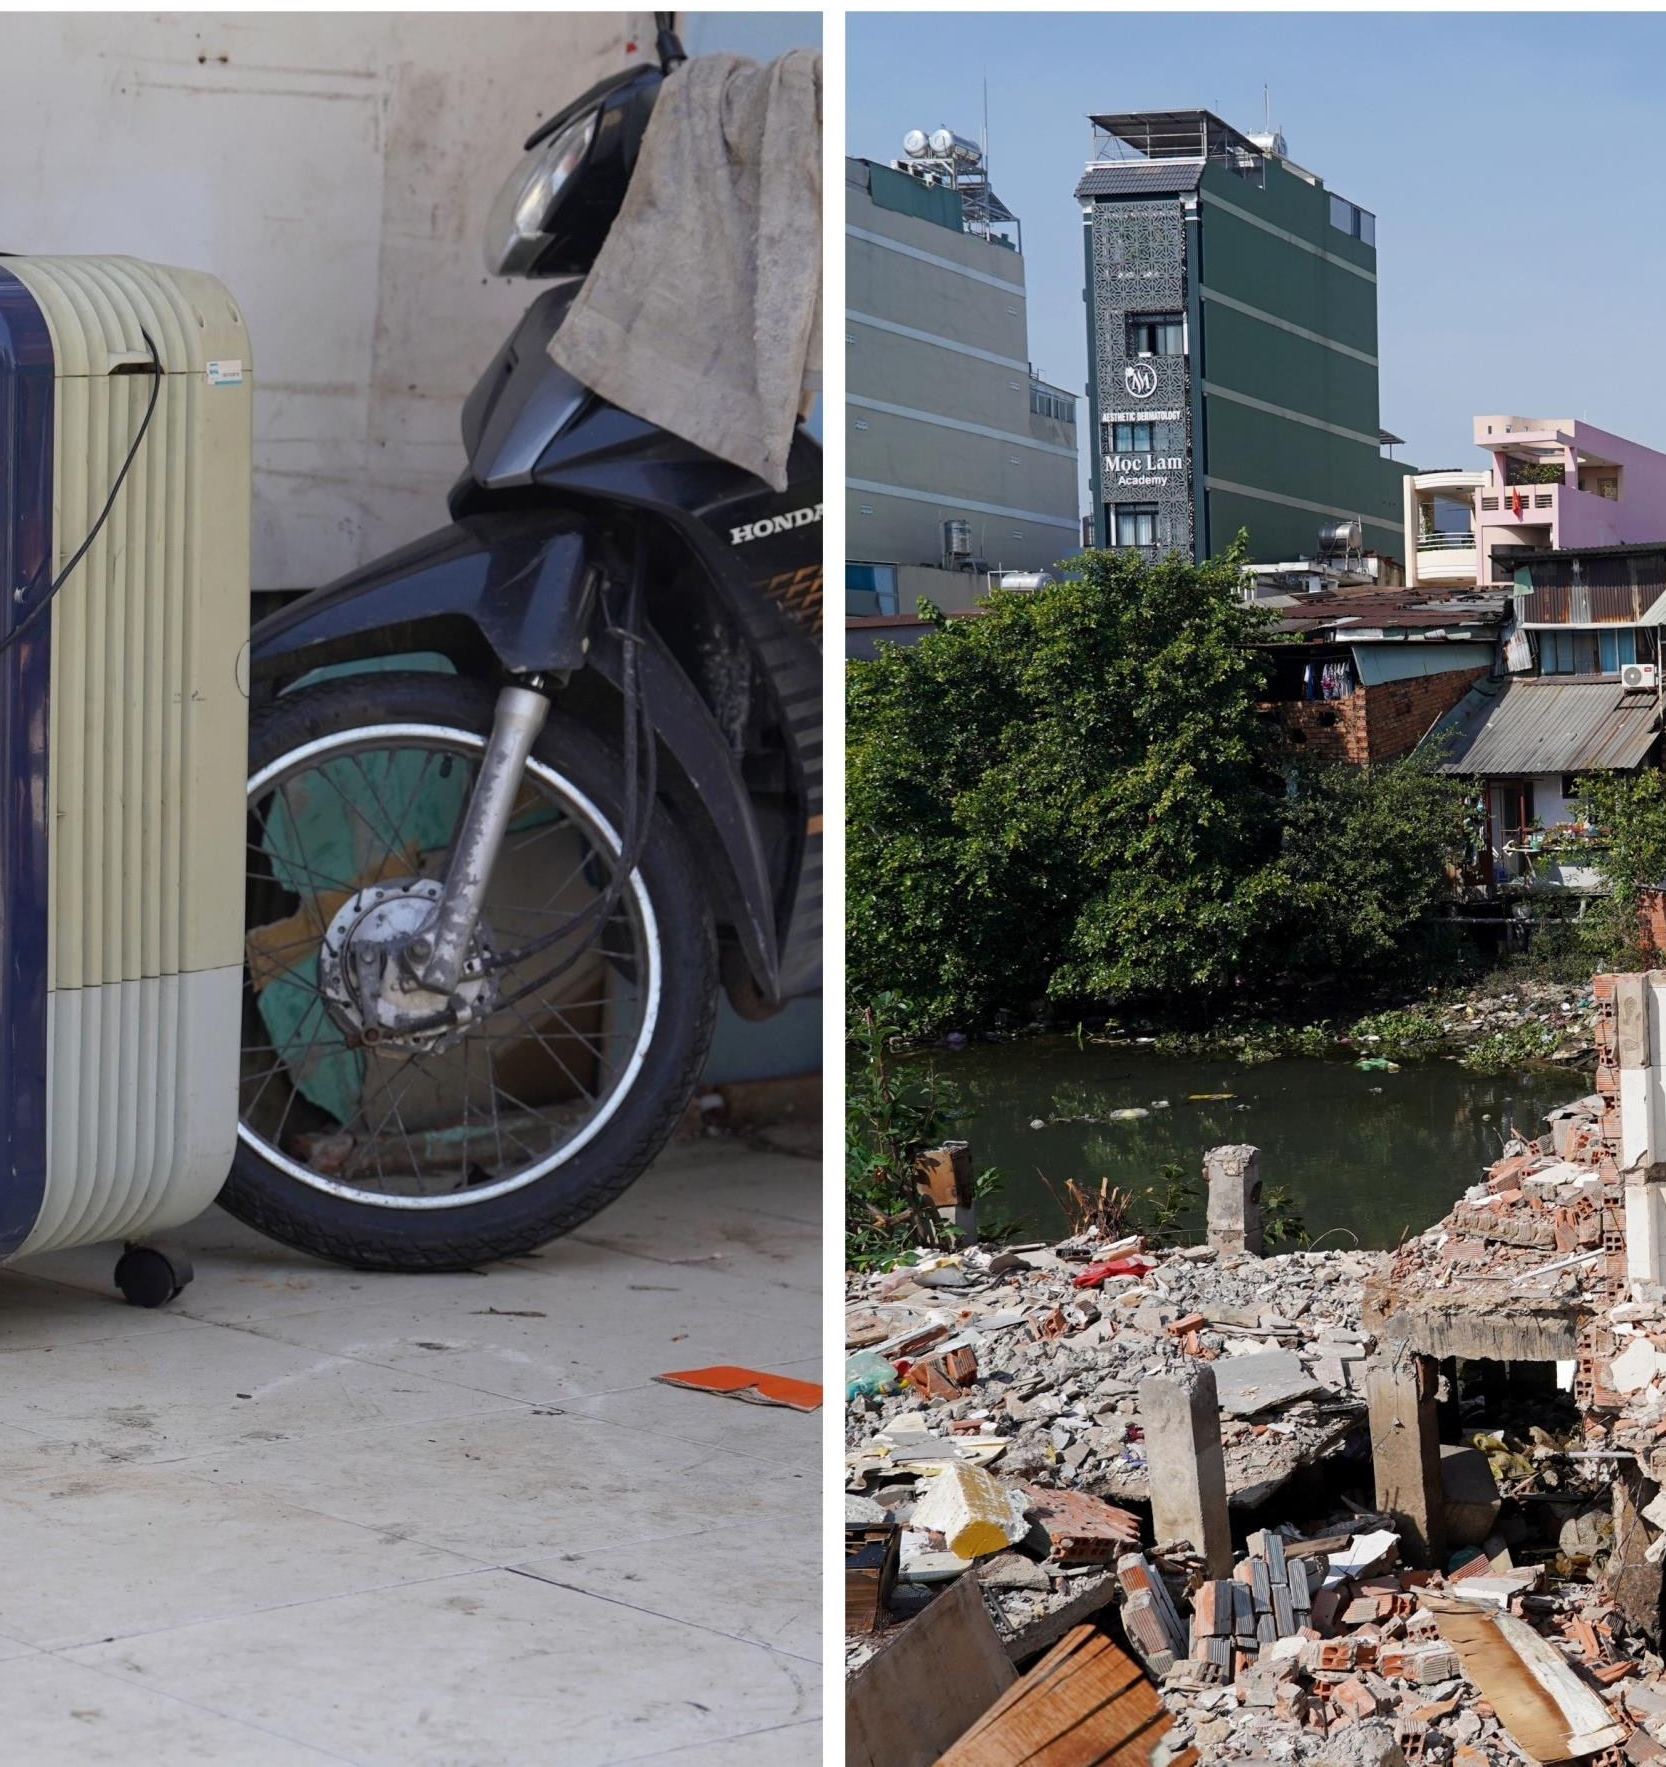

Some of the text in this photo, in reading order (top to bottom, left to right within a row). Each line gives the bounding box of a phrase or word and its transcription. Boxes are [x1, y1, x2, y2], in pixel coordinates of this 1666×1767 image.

[1102, 410, 1181, 423] AESTHETIC DERMATOLOGY
[1105, 454, 1183, 474] Mọc Lam
[1118, 475, 1168, 487] Academy
